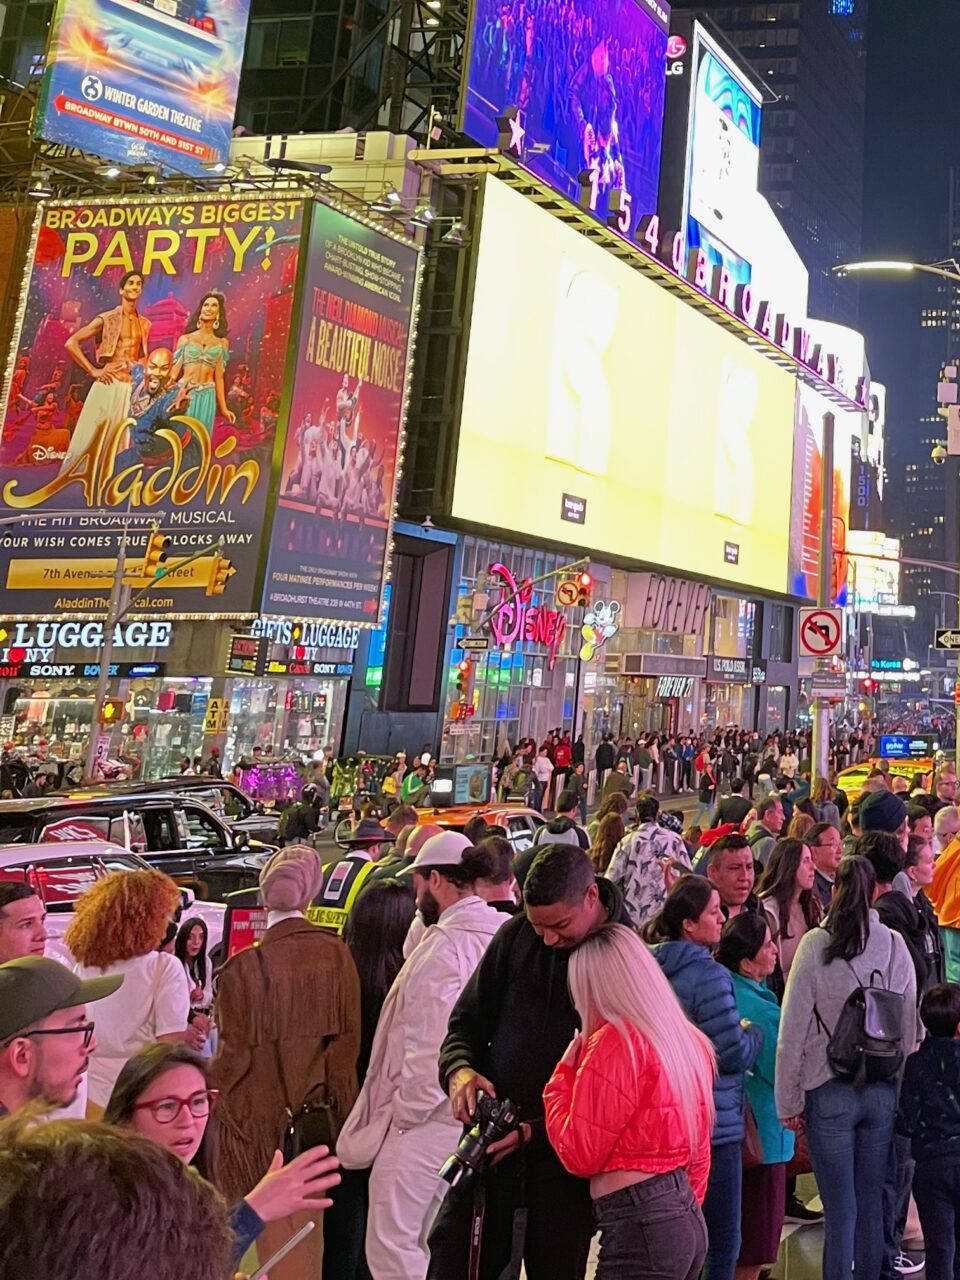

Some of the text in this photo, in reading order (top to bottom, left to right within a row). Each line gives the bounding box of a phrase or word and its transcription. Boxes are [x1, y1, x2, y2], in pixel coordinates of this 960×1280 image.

[104, 85, 202, 133] WINTER GARDEN THEATRE
[64, 101, 205, 156] BROADWAY BTWN 50TH AND 51ST ST
[46, 201, 301, 229] BROADWAY'S BIGGEST
[589, 169, 684, 270] 1540
[61, 226, 276, 278] PARTY!
[313, 286, 327, 317] THE
[326, 292, 343, 323] NEIL
[306, 316, 402, 393] A BEAUTIFUL NOISE
[3, 415, 260, 508] Aladdin
[52, 513, 74, 527] HIT
[170, 511, 235, 524] MUSICAL
[34, 537, 66, 548] WISH
[70, 536, 111, 548] COMES
[116, 536, 149, 547] TRUE
[43, 568, 57, 580] 7th
[642, 574, 711, 635] FOREVER
[13, 622, 172, 648] LUGGAGE
[250, 619, 360, 649] GIFTS LUGGAGE
[943, 635, 959, 644] ONE
[23, 648, 53, 663] NY
[314, 663, 336, 673] SONY
[30, 665, 75, 676] SONY
[655, 676, 686, 697] FOREVER
[206, 700, 218, 729] ATM
